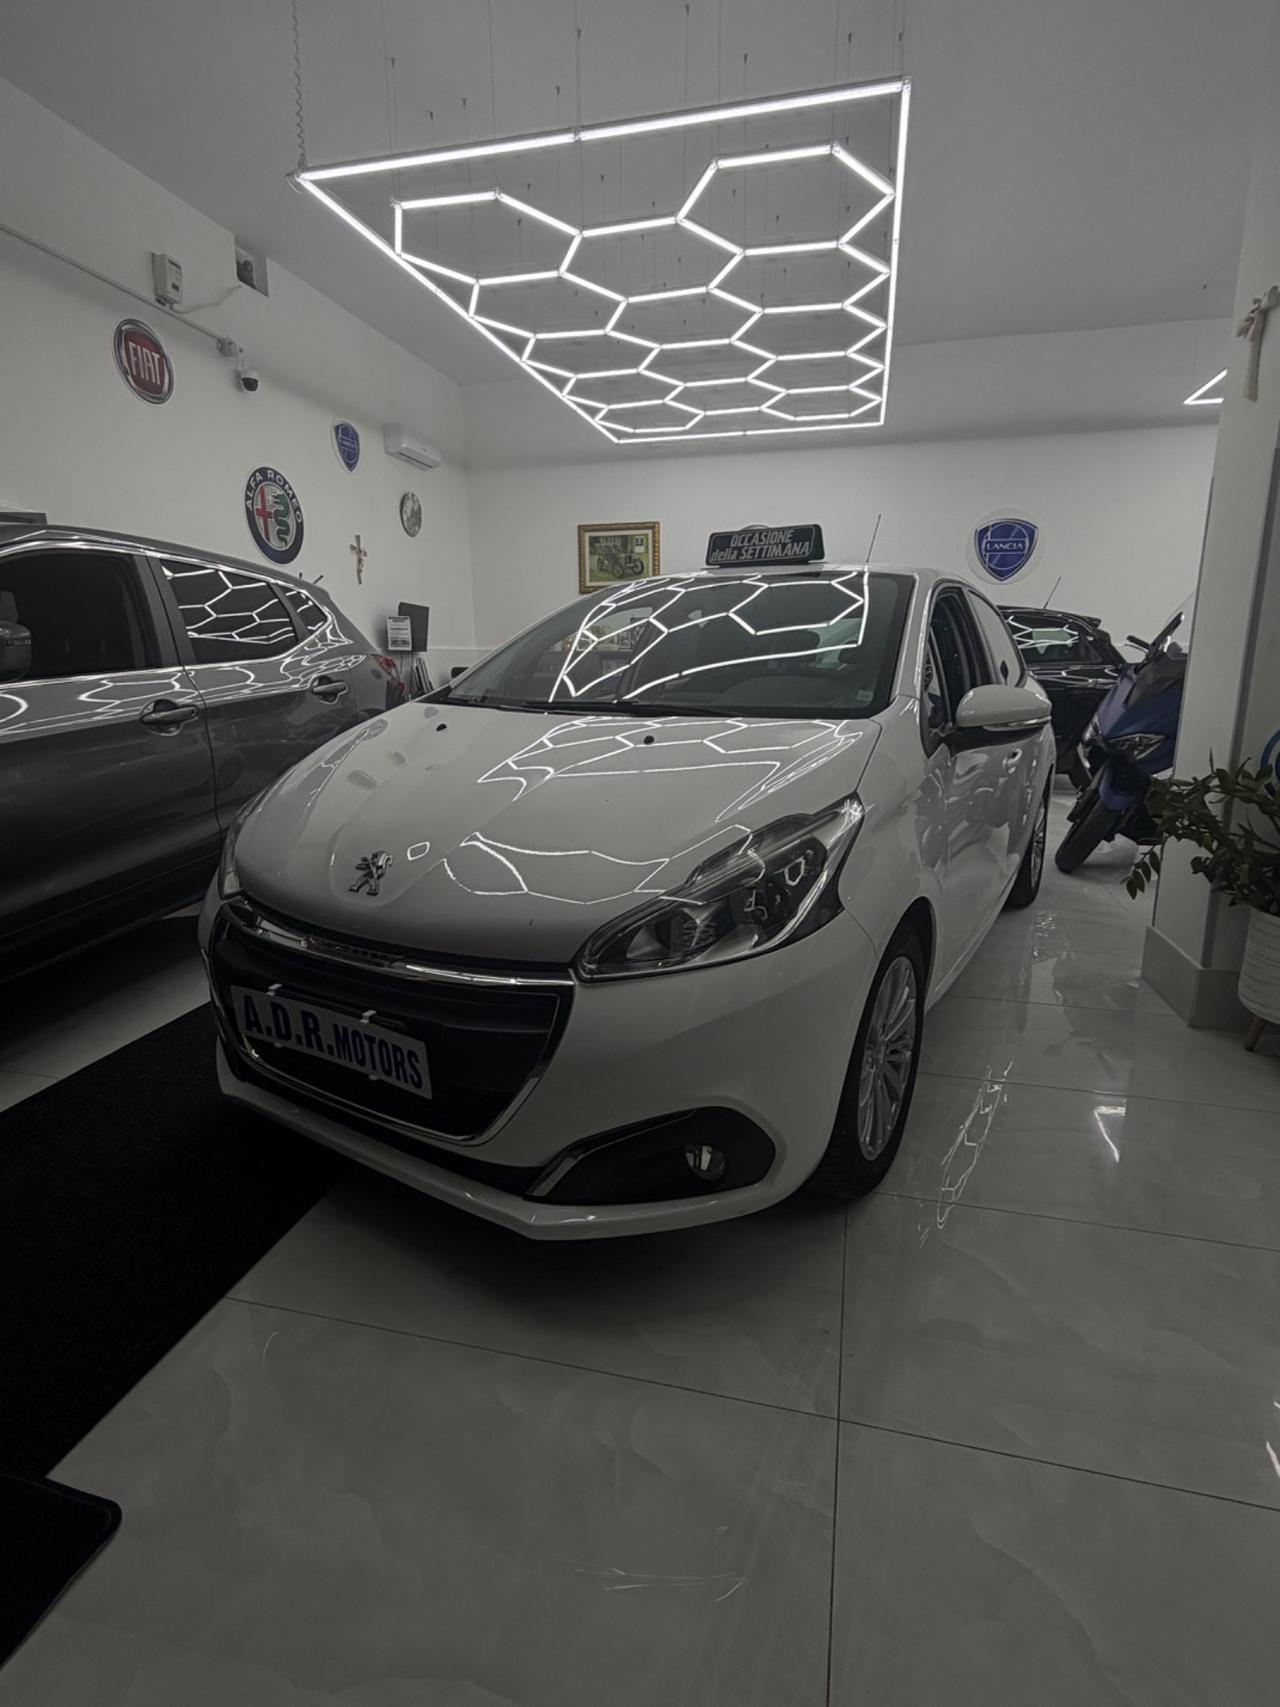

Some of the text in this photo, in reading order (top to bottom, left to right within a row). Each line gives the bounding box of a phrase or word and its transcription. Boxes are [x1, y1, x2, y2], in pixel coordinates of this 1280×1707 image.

[128, 341, 161, 385] FIAT
[246, 469, 302, 524] ALFA ROMEO
[730, 529, 795, 548] OCCASIONE
[986, 542, 1024, 551] LANCIA
[710, 541, 810, 561] della SETTIMANA
